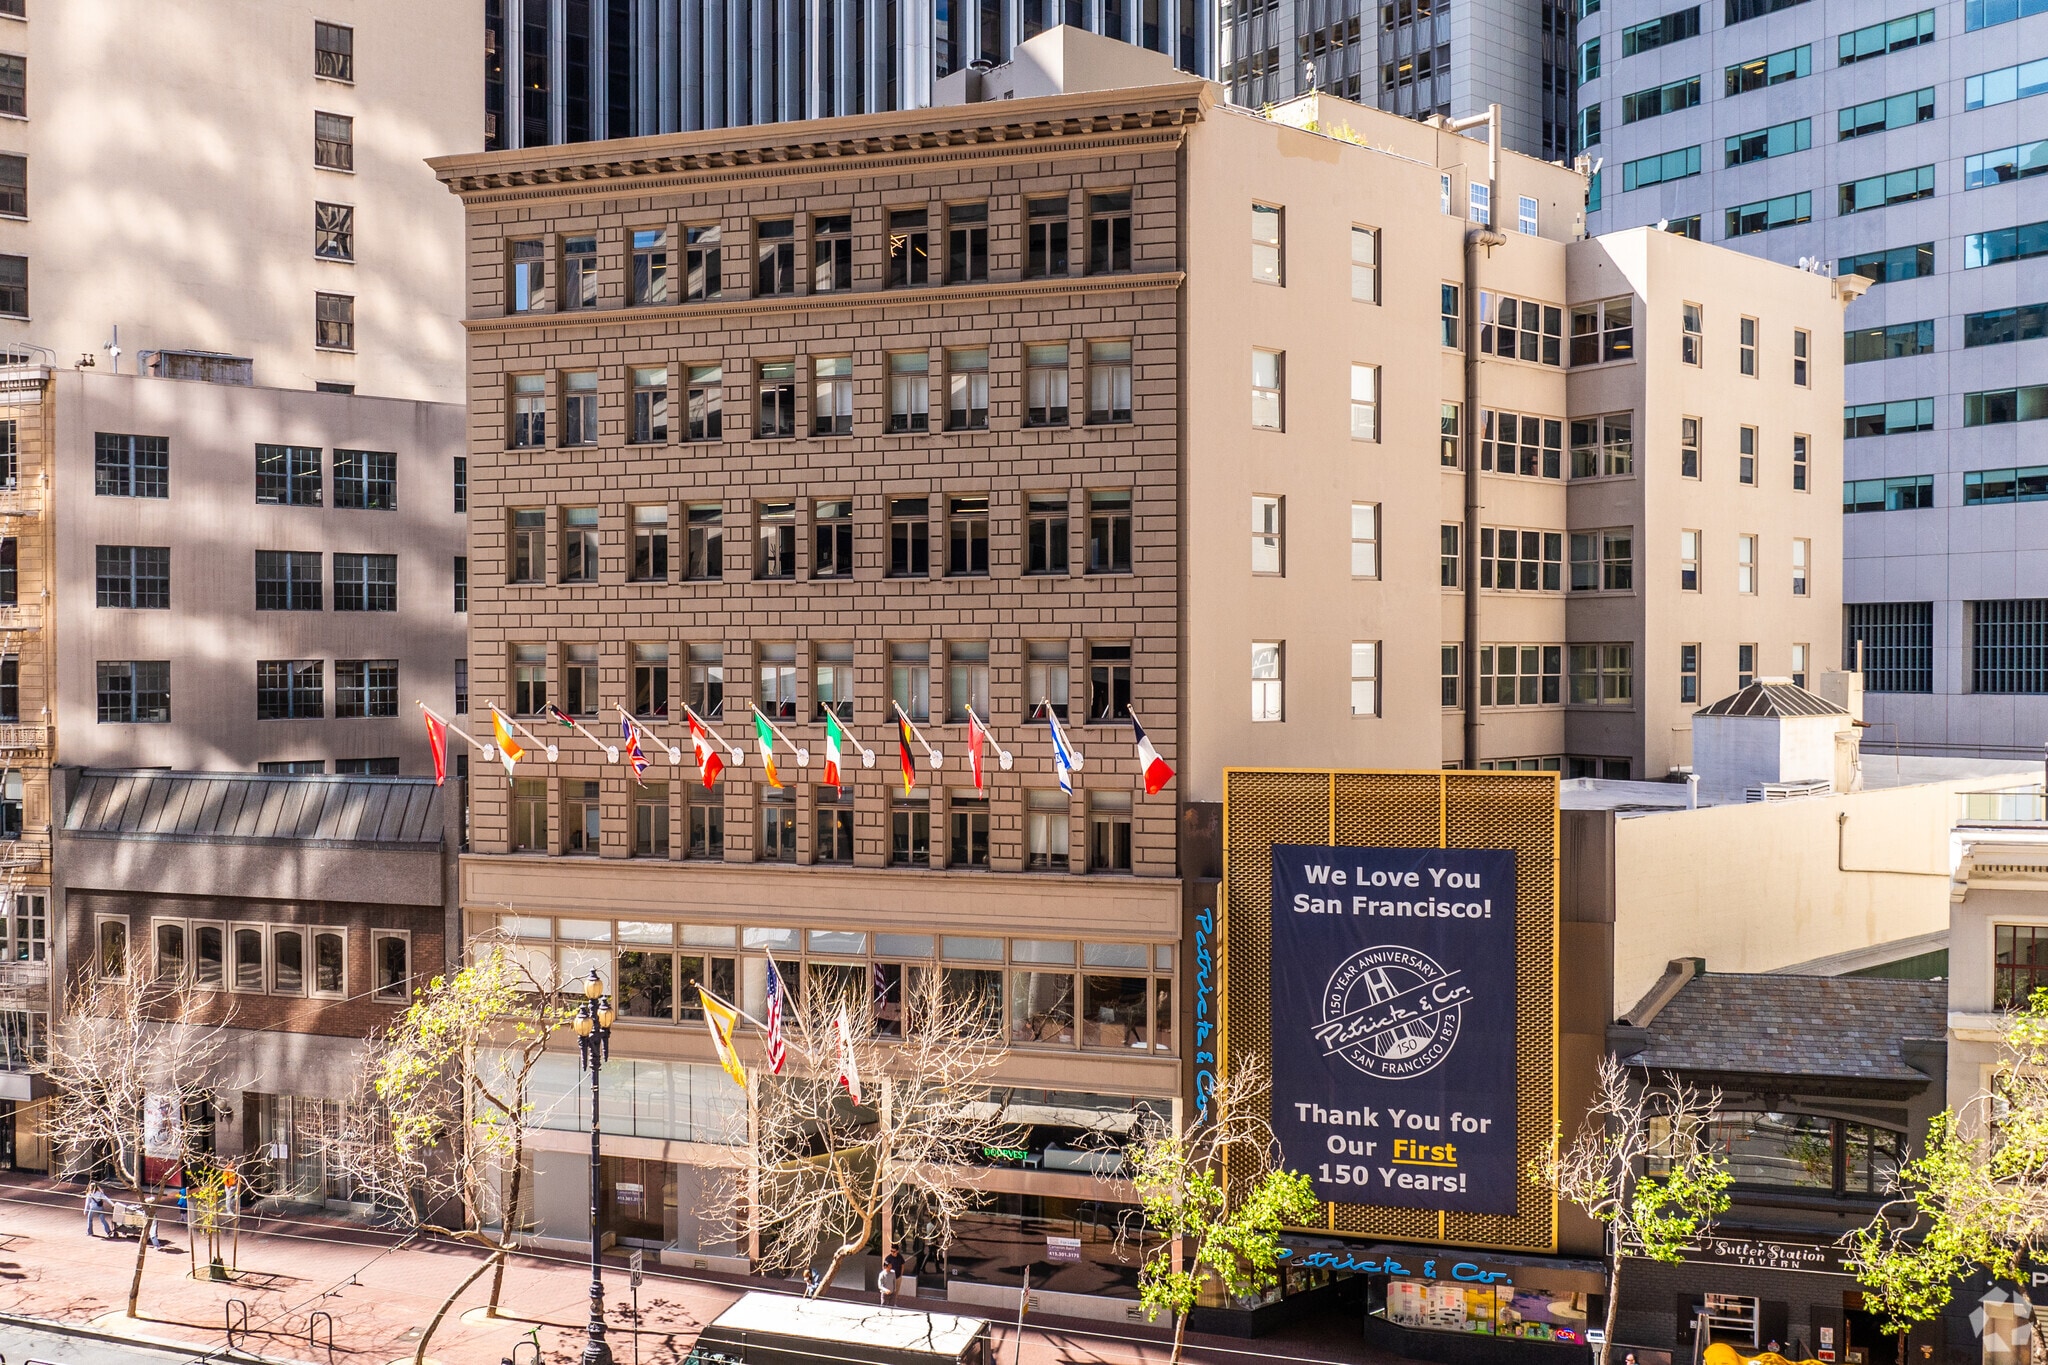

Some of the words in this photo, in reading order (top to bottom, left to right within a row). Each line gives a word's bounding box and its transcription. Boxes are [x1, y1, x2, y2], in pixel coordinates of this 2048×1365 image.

[1304, 864, 1347, 886] We
[1356, 866, 1420, 888] Love
[1428, 868, 1481, 889] You
[1293, 894, 1342, 914] San
[1352, 896, 1491, 918] Francisco!
[1196, 907, 1213, 1046] Patrick
[1358, 952, 1438, 978] ANNIVERSARY
[1334, 966, 1358, 992] YEAR
[1315, 1005, 1418, 1050] Patrick
[1419, 996, 1432, 1011] &
[1432, 982, 1471, 1004] Co.
[1330, 994, 1342, 1015] 150
[1350, 1050, 1374, 1069] SAN
[1382, 1044, 1443, 1074] FRANCISCO
[1440, 1014, 1456, 1042] 1873
[1396, 1038, 1418, 1055] 150
[1196, 1051, 1214, 1064] &
[1294, 1102, 1380, 1127] Thank
[1388, 1108, 1440, 1131] You
[1450, 1112, 1492, 1134] for
[1326, 1134, 1377, 1156] Our
[1392, 1138, 1457, 1163] First
[1318, 1163, 1369, 1186] 150
[1378, 1167, 1467, 1193] Years!
[1715, 1240, 1765, 1256] Sutter
[1767, 1244, 1825, 1262] Station
[1738, 1256, 1800, 1268] TAVERN
[1424, 1260, 1436, 1278] &
[1452, 1262, 1512, 1284] Co.
